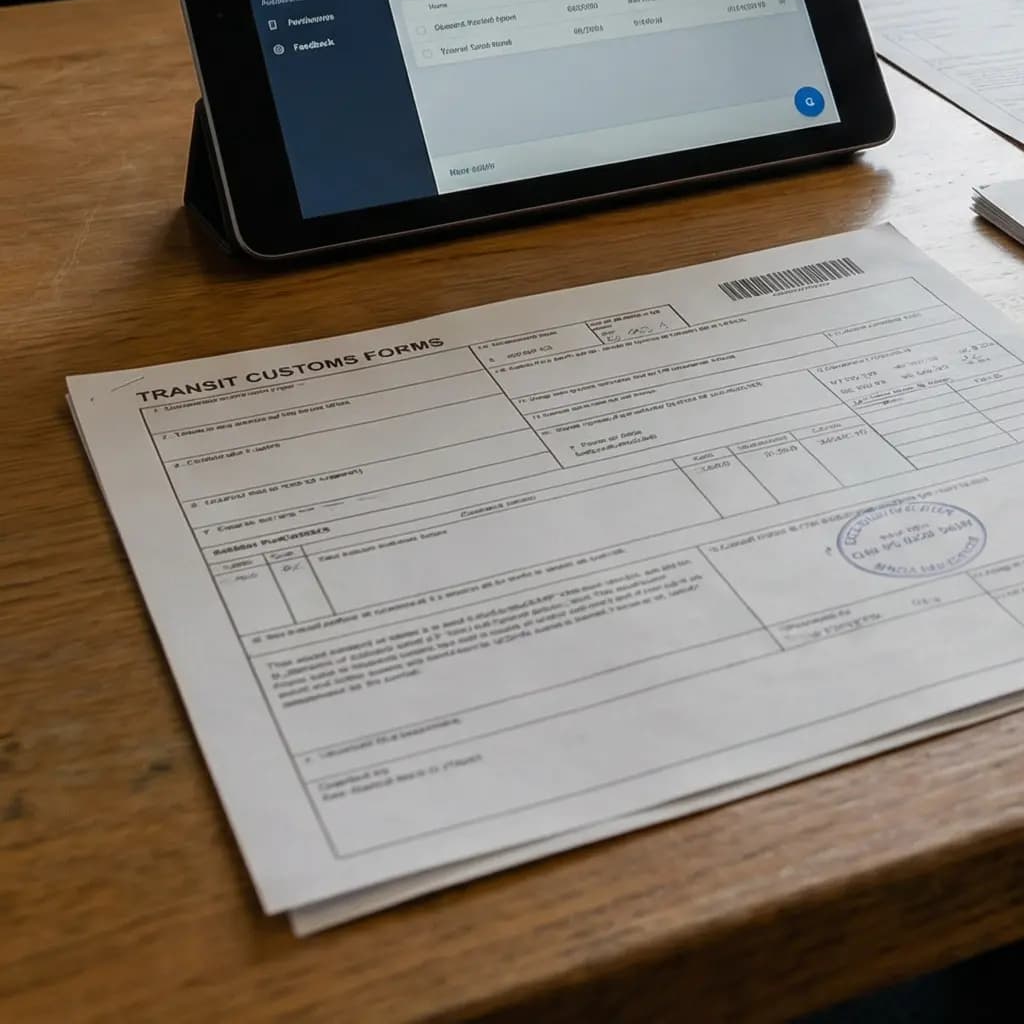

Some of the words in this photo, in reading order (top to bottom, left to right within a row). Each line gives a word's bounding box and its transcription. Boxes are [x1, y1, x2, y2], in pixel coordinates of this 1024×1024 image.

[135, 375, 239, 403] TRANSIT
[245, 354, 360, 383] CUSTOMS
[363, 336, 445, 362] FORMS
